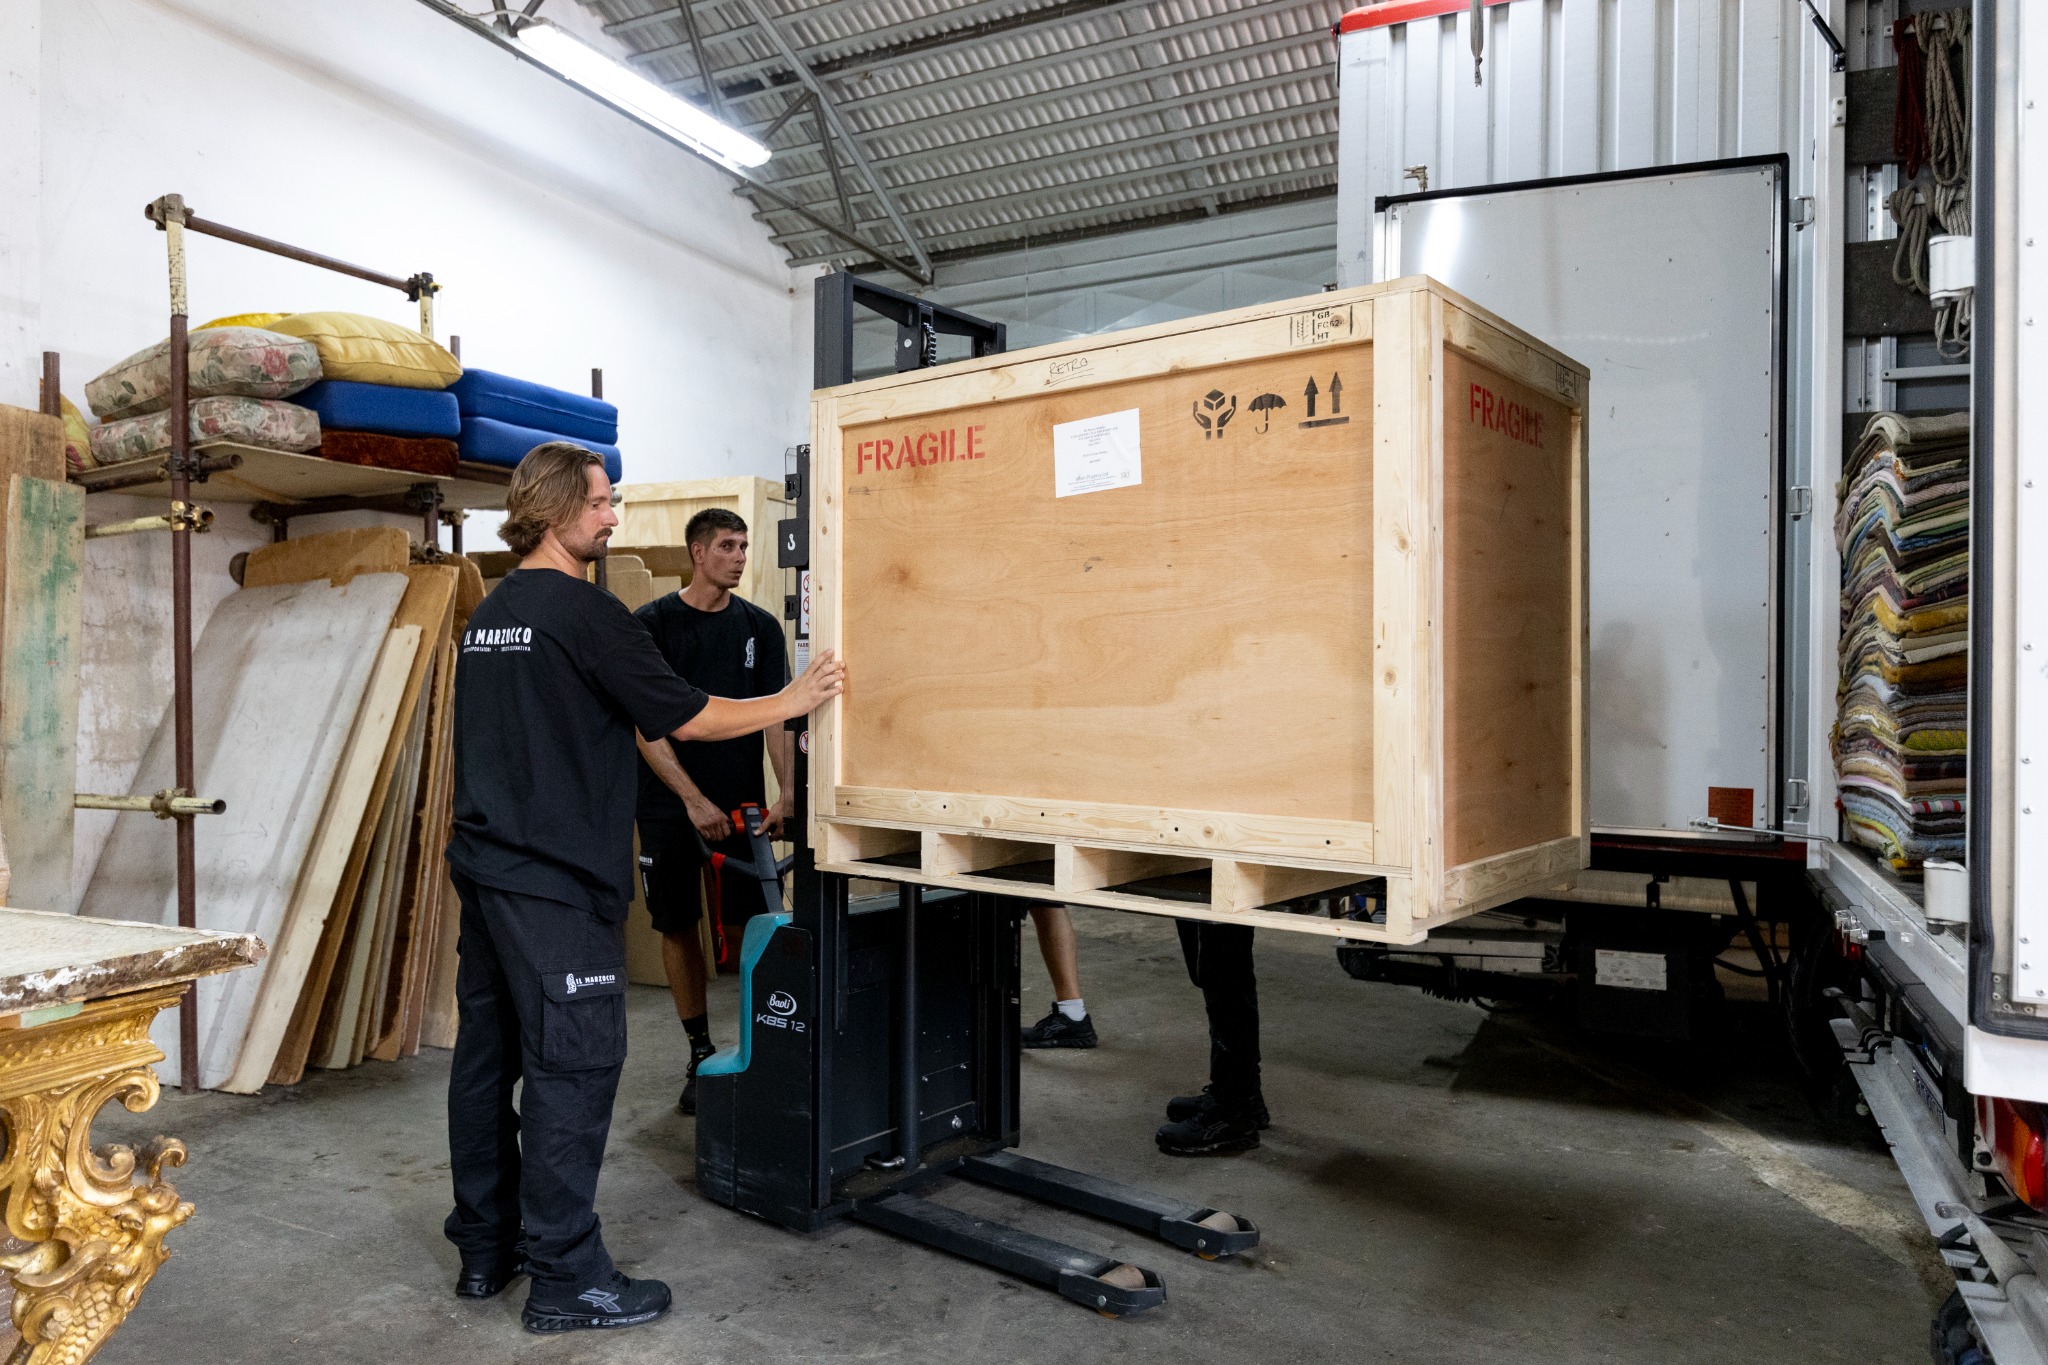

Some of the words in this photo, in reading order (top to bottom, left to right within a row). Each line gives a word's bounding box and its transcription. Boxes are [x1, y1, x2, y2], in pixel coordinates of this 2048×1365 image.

[1318, 332, 1330, 340] HT
[1049, 357, 1088, 378] RETRO
[1469, 382, 1543, 450] FRAGILE
[857, 424, 986, 475] FRAGILE
[464, 630, 472, 646] IL
[474, 626, 532, 645] MARZOCCO
[575, 977, 582, 985] IL
[584, 974, 616, 984] MARZOCCO
[769, 993, 791, 1009] Baoli
[756, 1013, 788, 1029] KBS
[790, 1020, 806, 1033] 12
